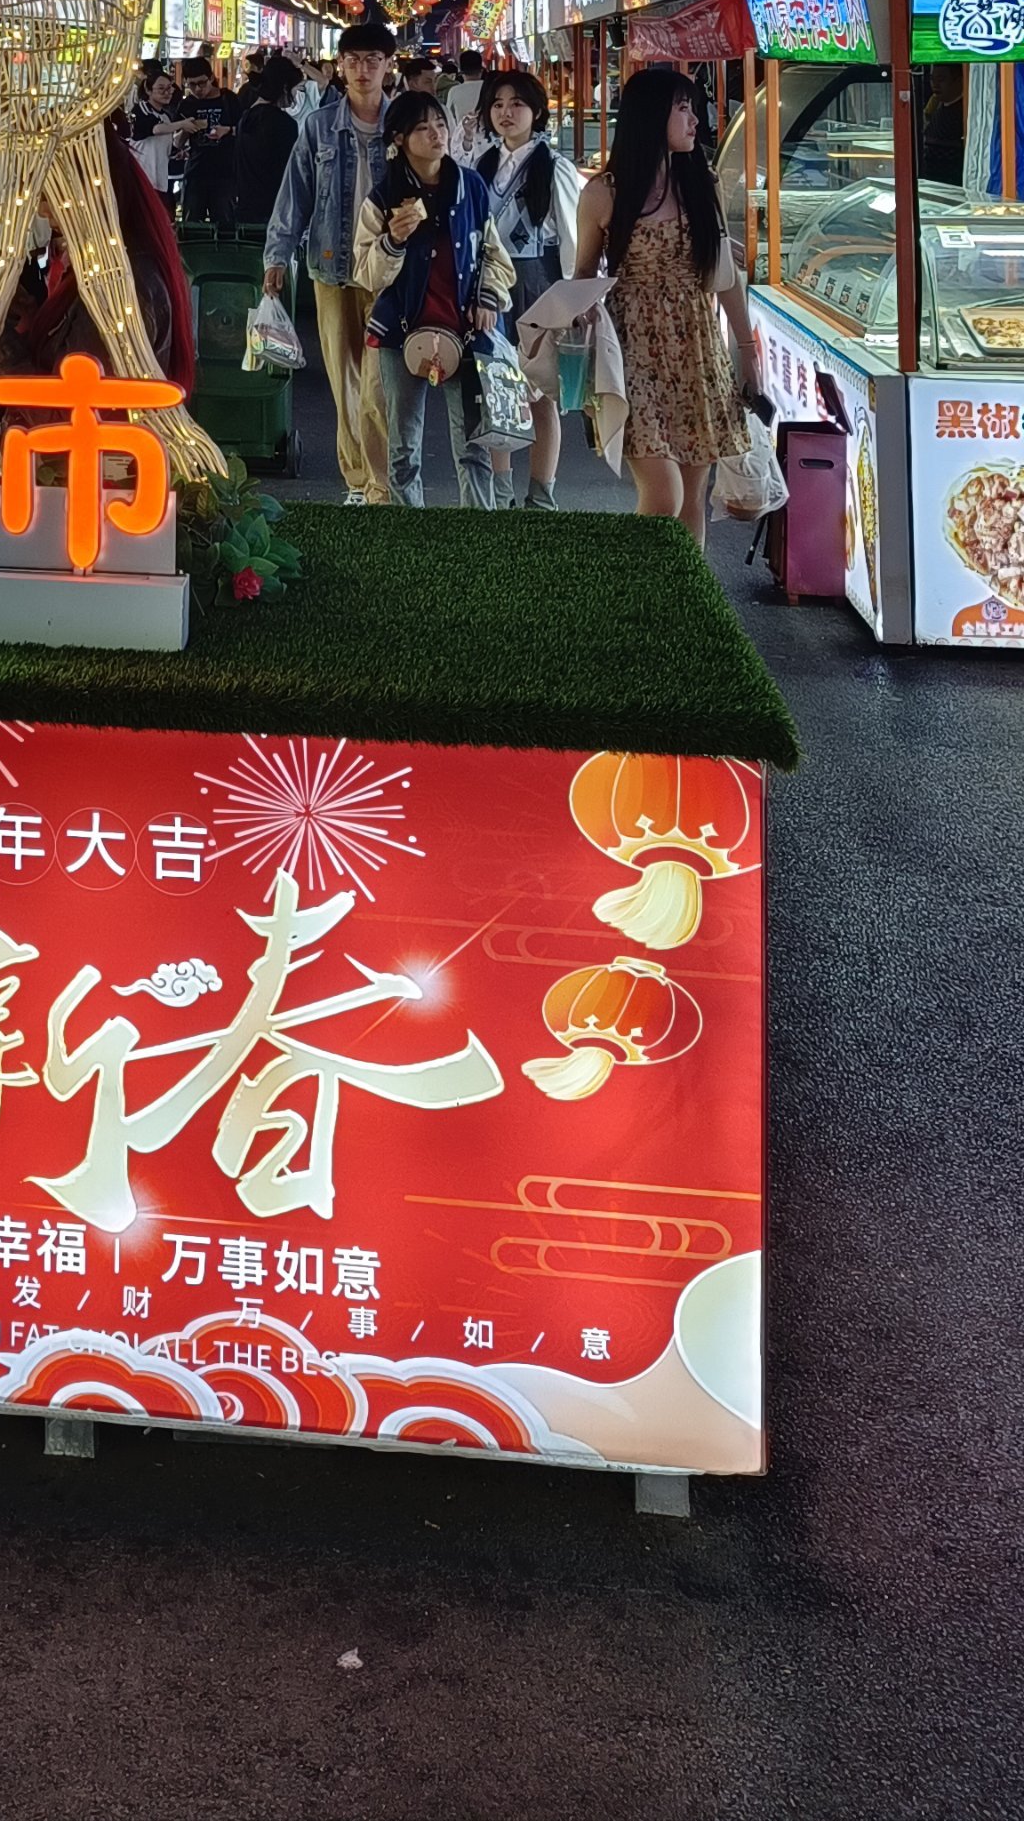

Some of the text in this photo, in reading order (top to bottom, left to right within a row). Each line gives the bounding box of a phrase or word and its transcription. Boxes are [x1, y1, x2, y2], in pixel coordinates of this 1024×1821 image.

[935, 399, 1024, 440] 黑椒
[161, 1232, 382, 1301] 万事如意
[10, 1322, 60, 1350] FAT
[154, 1336, 206, 1366] ALL
[213, 1340, 273, 1372] THE
[280, 1346, 354, 1380] BEST
